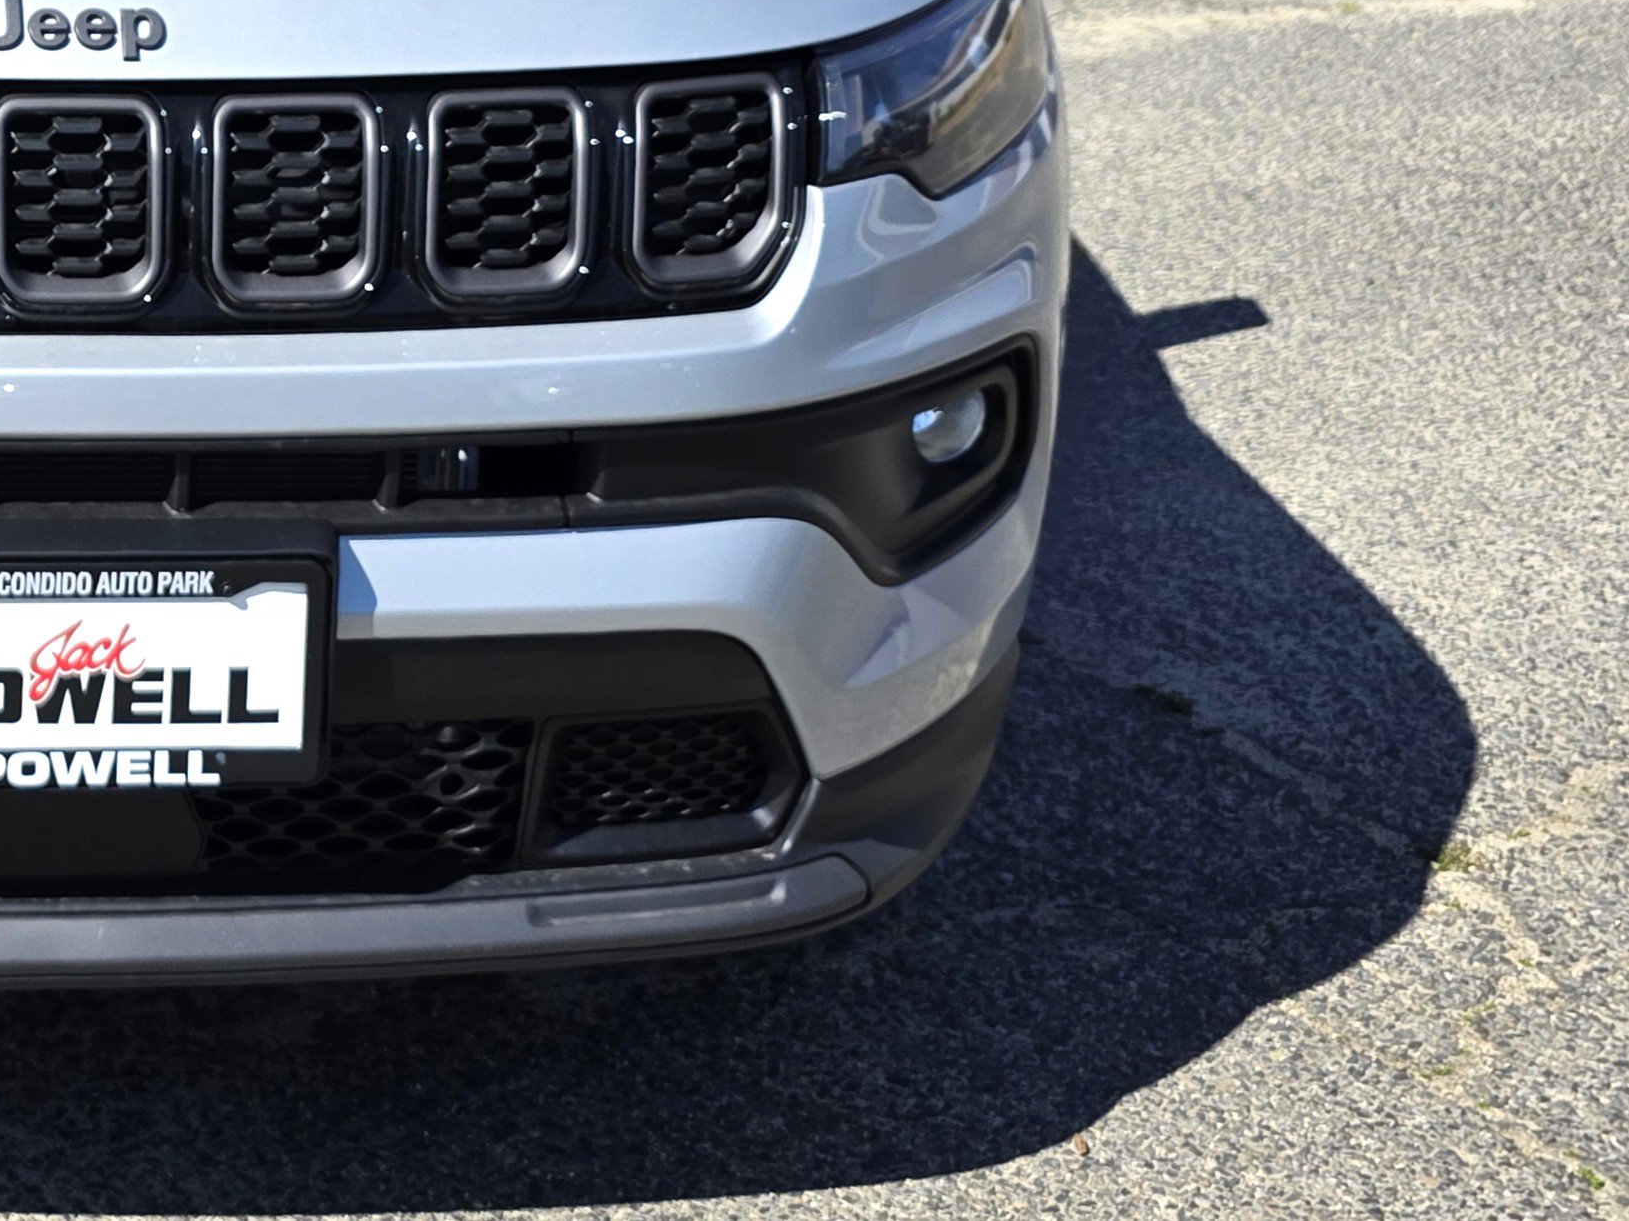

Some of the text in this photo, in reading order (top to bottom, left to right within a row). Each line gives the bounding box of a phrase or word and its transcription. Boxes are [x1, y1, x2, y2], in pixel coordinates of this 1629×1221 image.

[96, 572, 154, 596] AUTO
[157, 571, 214, 595] PARK
[28, 620, 147, 704] Jack
